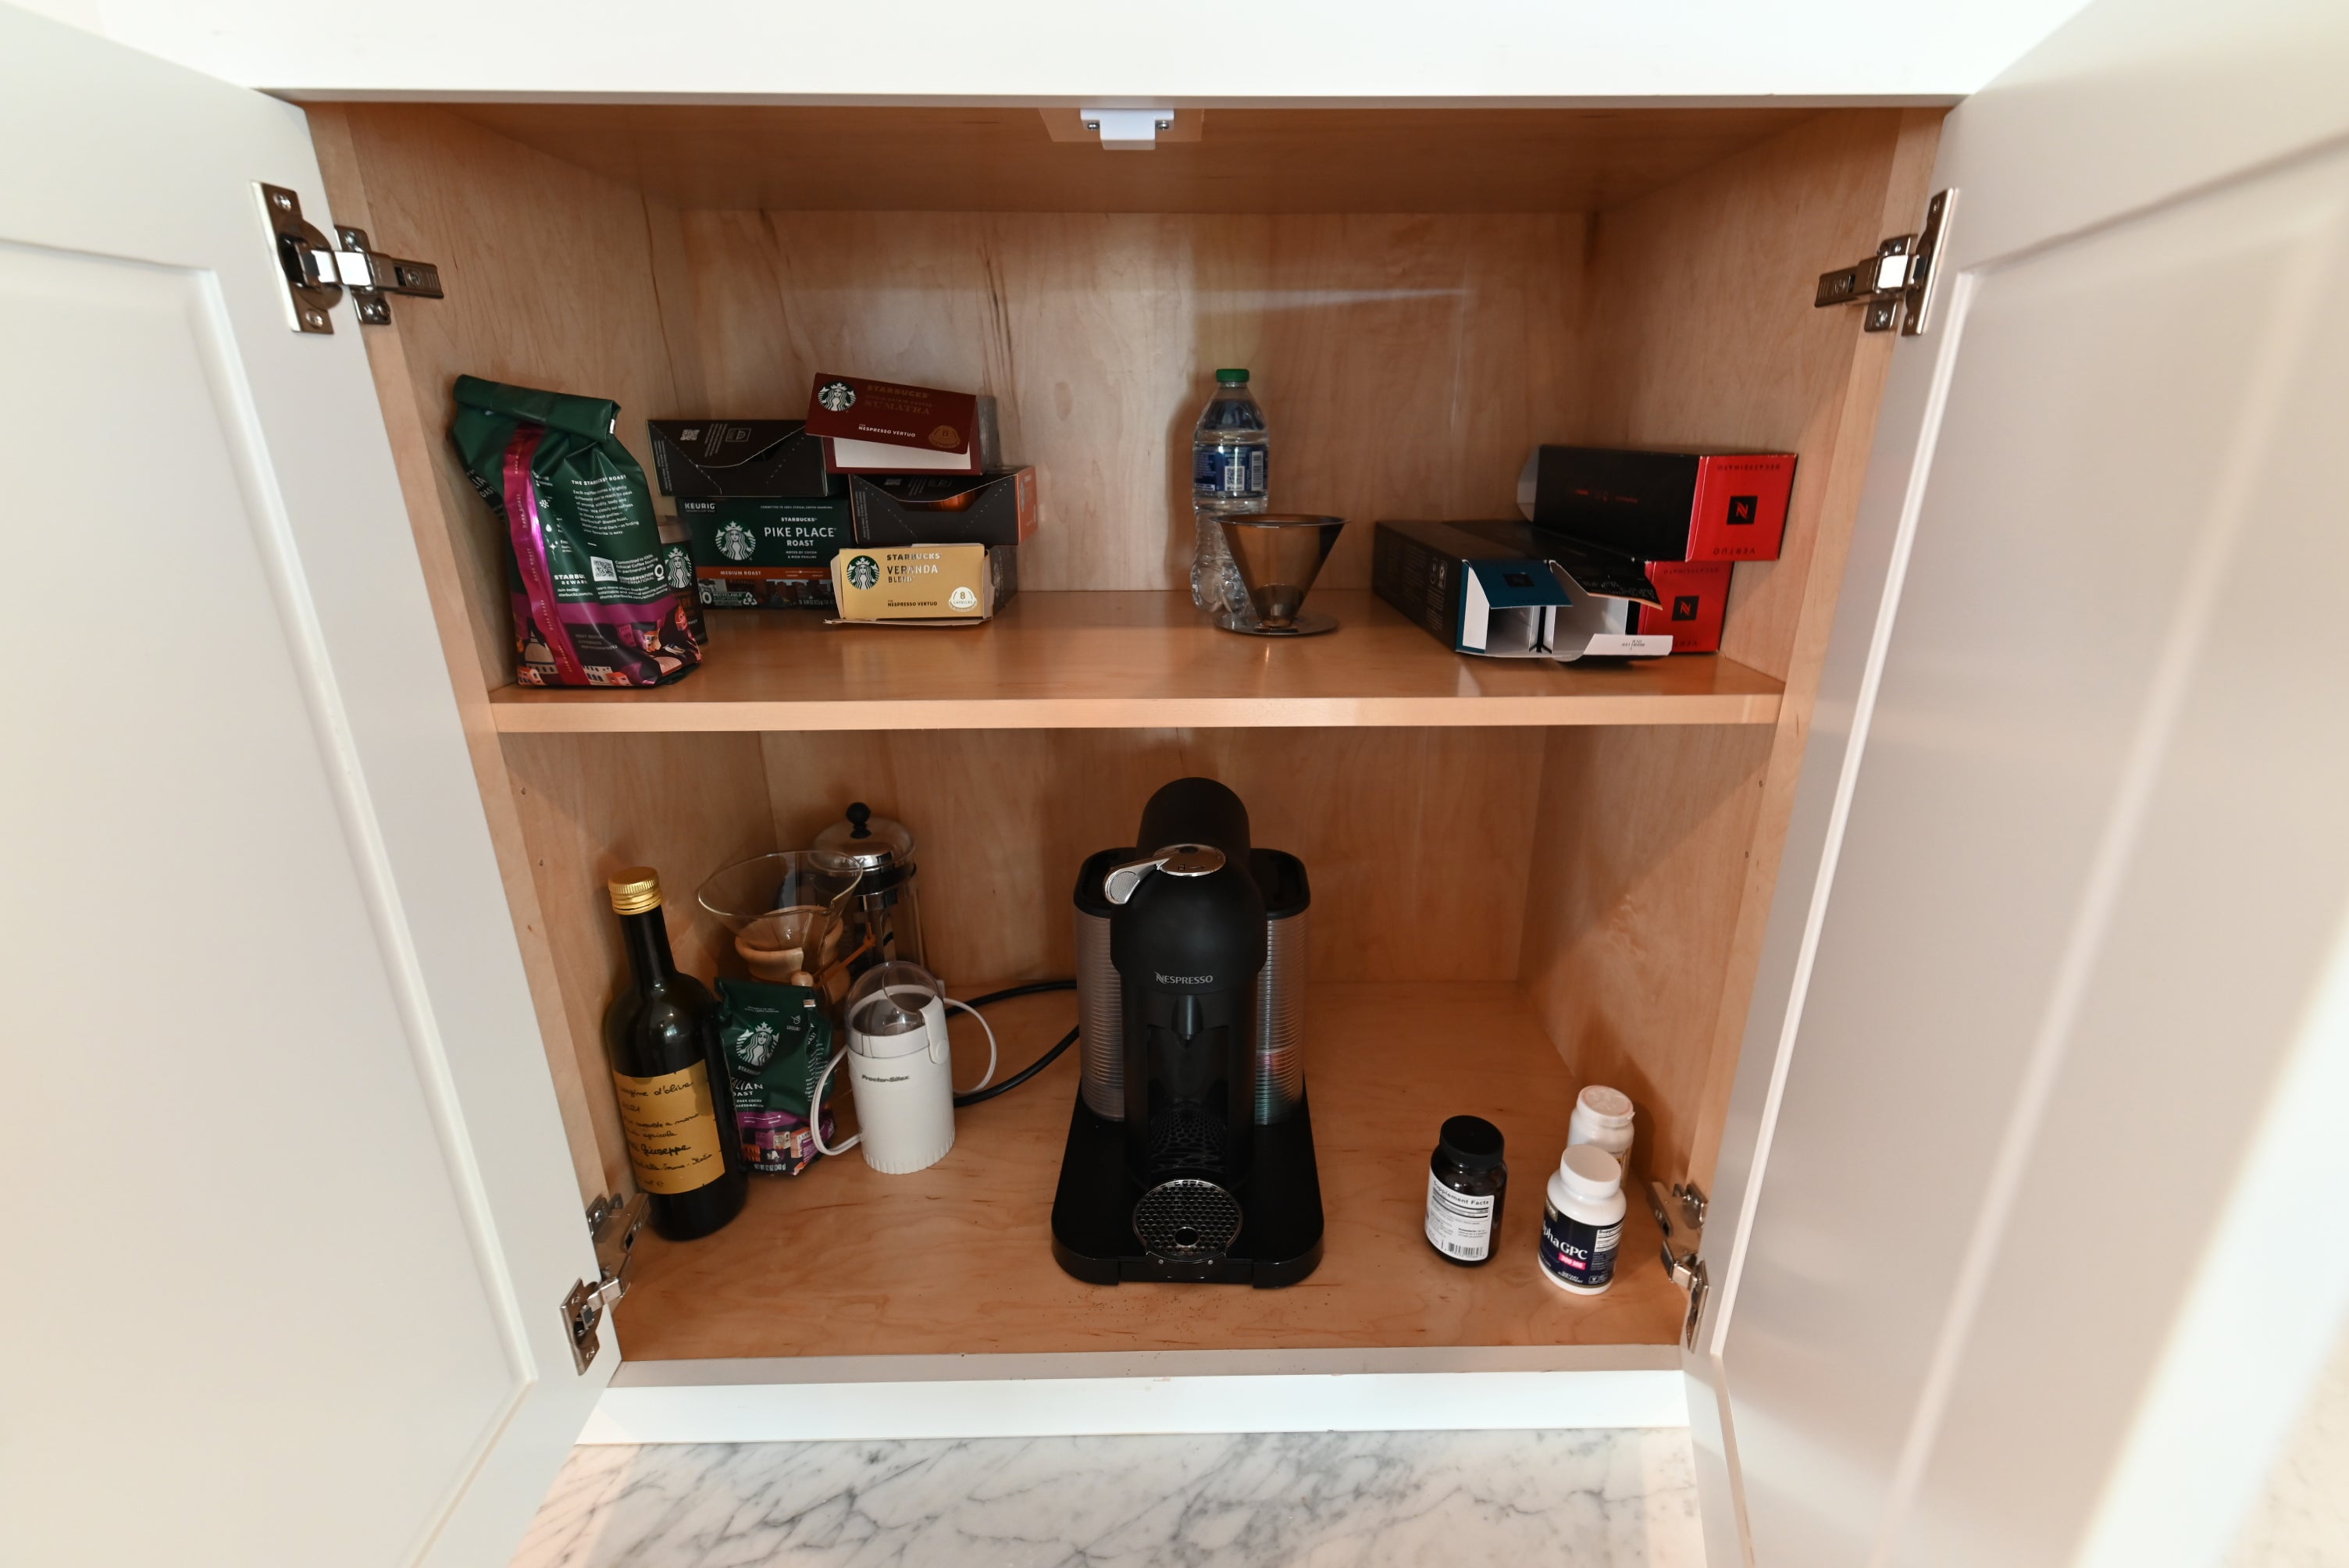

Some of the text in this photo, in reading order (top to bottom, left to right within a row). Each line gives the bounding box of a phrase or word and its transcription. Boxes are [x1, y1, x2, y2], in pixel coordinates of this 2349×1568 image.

[858, 426, 892, 435] NESPRESSO
[764, 526, 835, 538] PIKE PLACE
[1712, 547, 1756, 556] VERTUO
[887, 552, 941, 561] STARBUCKS
[887, 565, 939, 575] VERANDA
[960, 591, 966, 600] 8
[1674, 640, 1698, 648] VERT
[1154, 971, 1214, 985] NESPRESSO
[1433, 1180, 1469, 1205] Supplement
[1560, 1242, 1588, 1260] GPC
